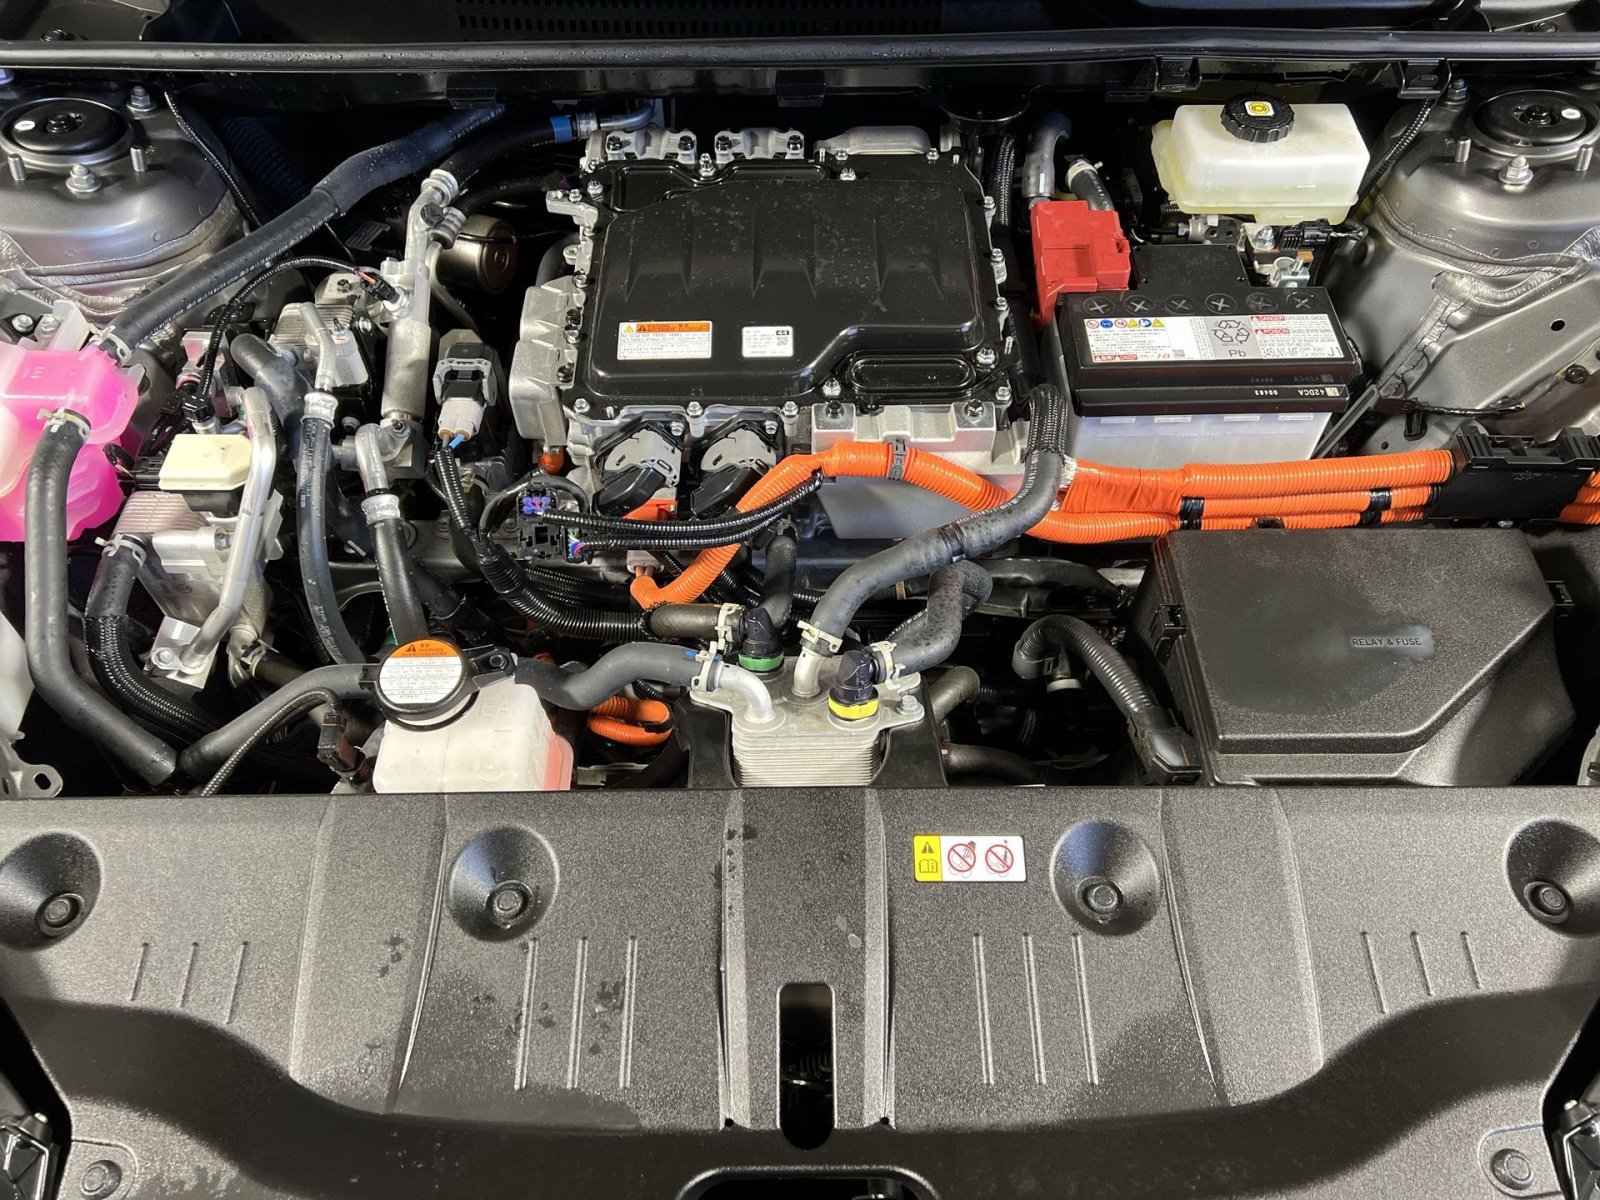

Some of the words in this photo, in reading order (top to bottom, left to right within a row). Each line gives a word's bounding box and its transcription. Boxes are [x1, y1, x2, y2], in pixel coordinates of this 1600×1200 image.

[1229, 349, 1247, 357] Pb
[1352, 638, 1383, 646] RELAY
[1387, 638, 1394, 646] &
[1396, 637, 1422, 646] FUSE
